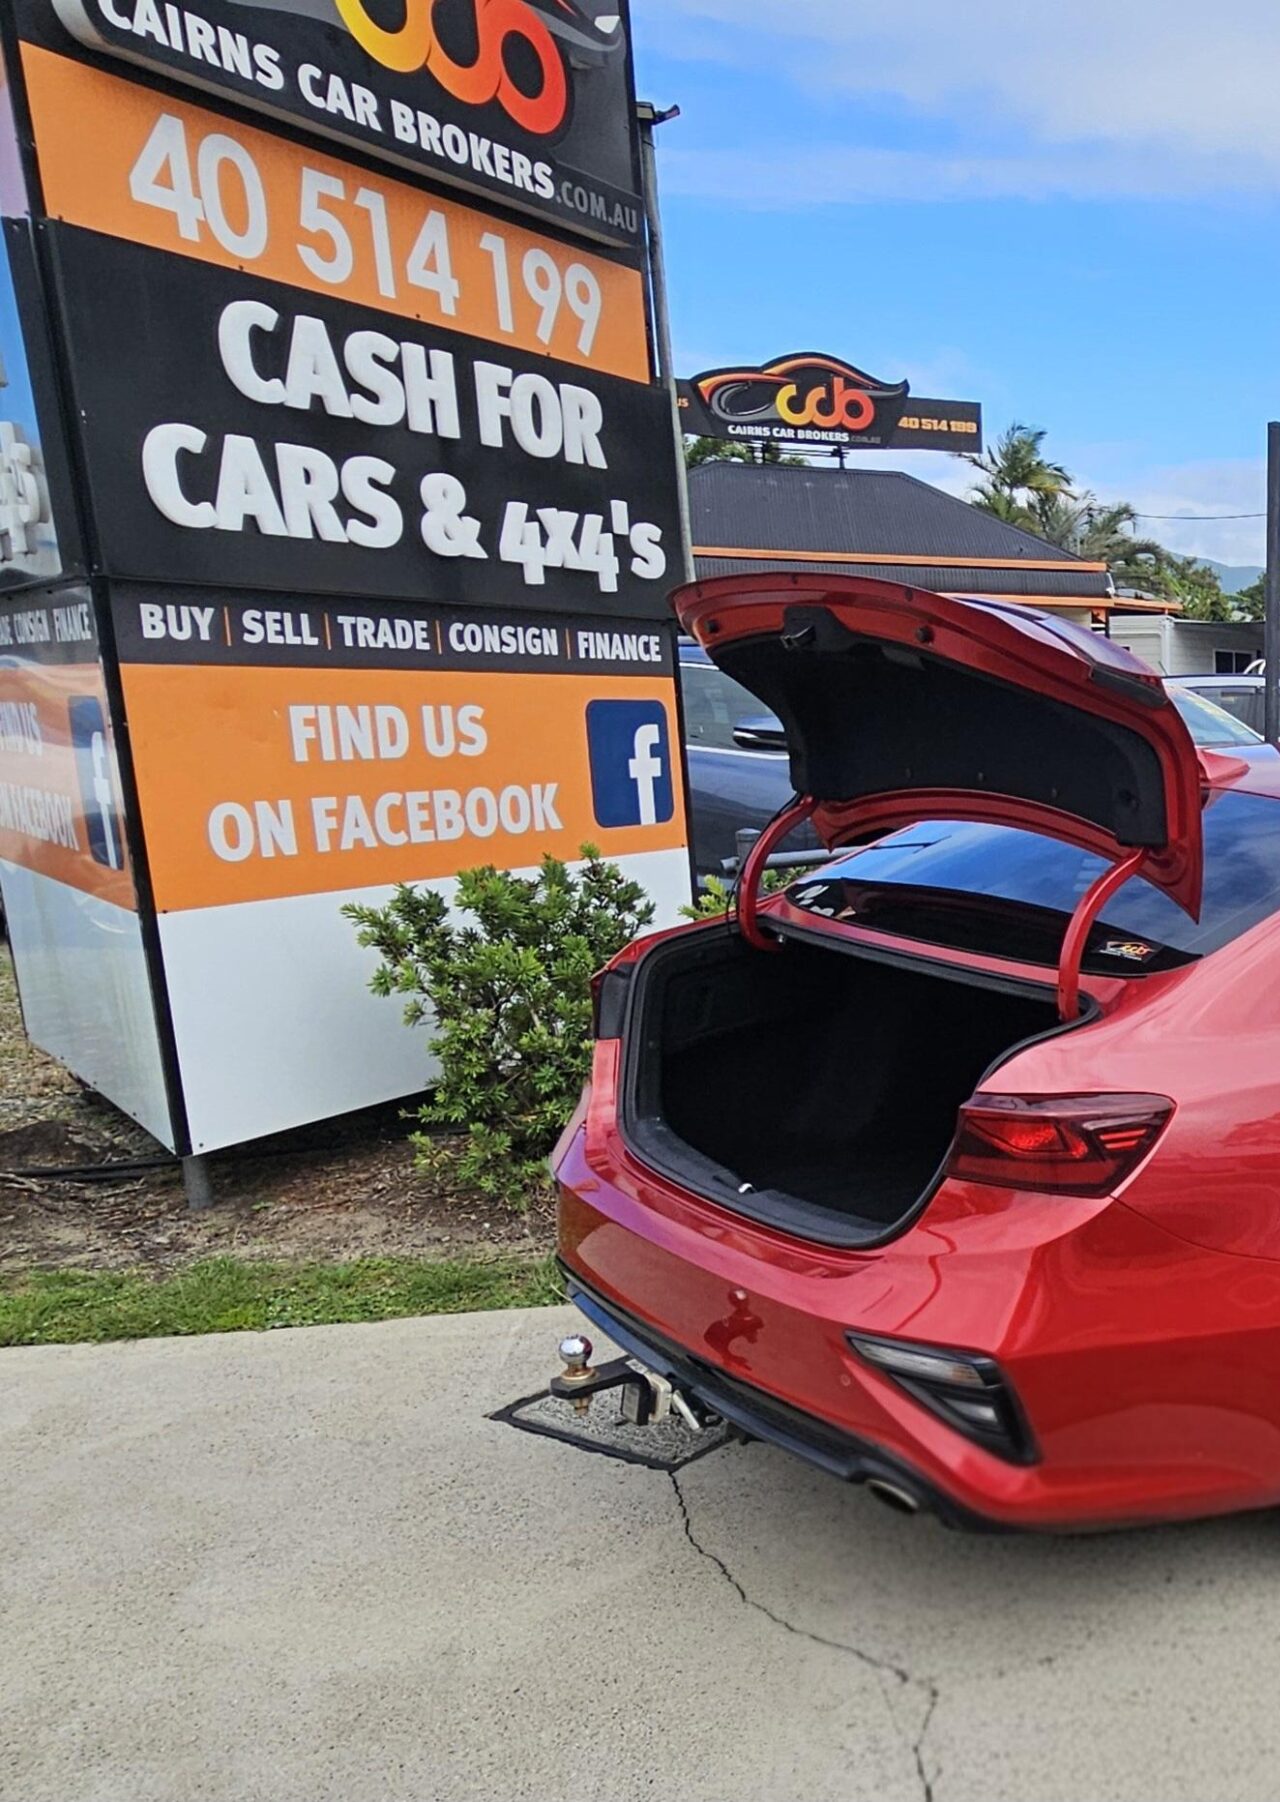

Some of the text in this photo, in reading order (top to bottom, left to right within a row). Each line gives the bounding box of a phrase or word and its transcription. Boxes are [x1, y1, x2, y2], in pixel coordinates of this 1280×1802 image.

[98, 0, 284, 91] CAIRNS
[297, 62, 382, 132] CAR
[129, 113, 601, 356] 40 514 199
[218, 300, 608, 469] CASH FOR
[727, 424, 771, 437] CAIRNS
[772, 427, 795, 438] CAR
[797, 430, 850, 442] BROKERS
[921, 418, 948, 431] 514
[142, 423, 404, 549] CARS
[419, 472, 488, 560] &
[140, 603, 662, 662] BUY SELL TRADE CONSIGN FINANCE
[288, 704, 488, 763] FIND US
[207, 783, 563, 861] ON FACEBOOK
